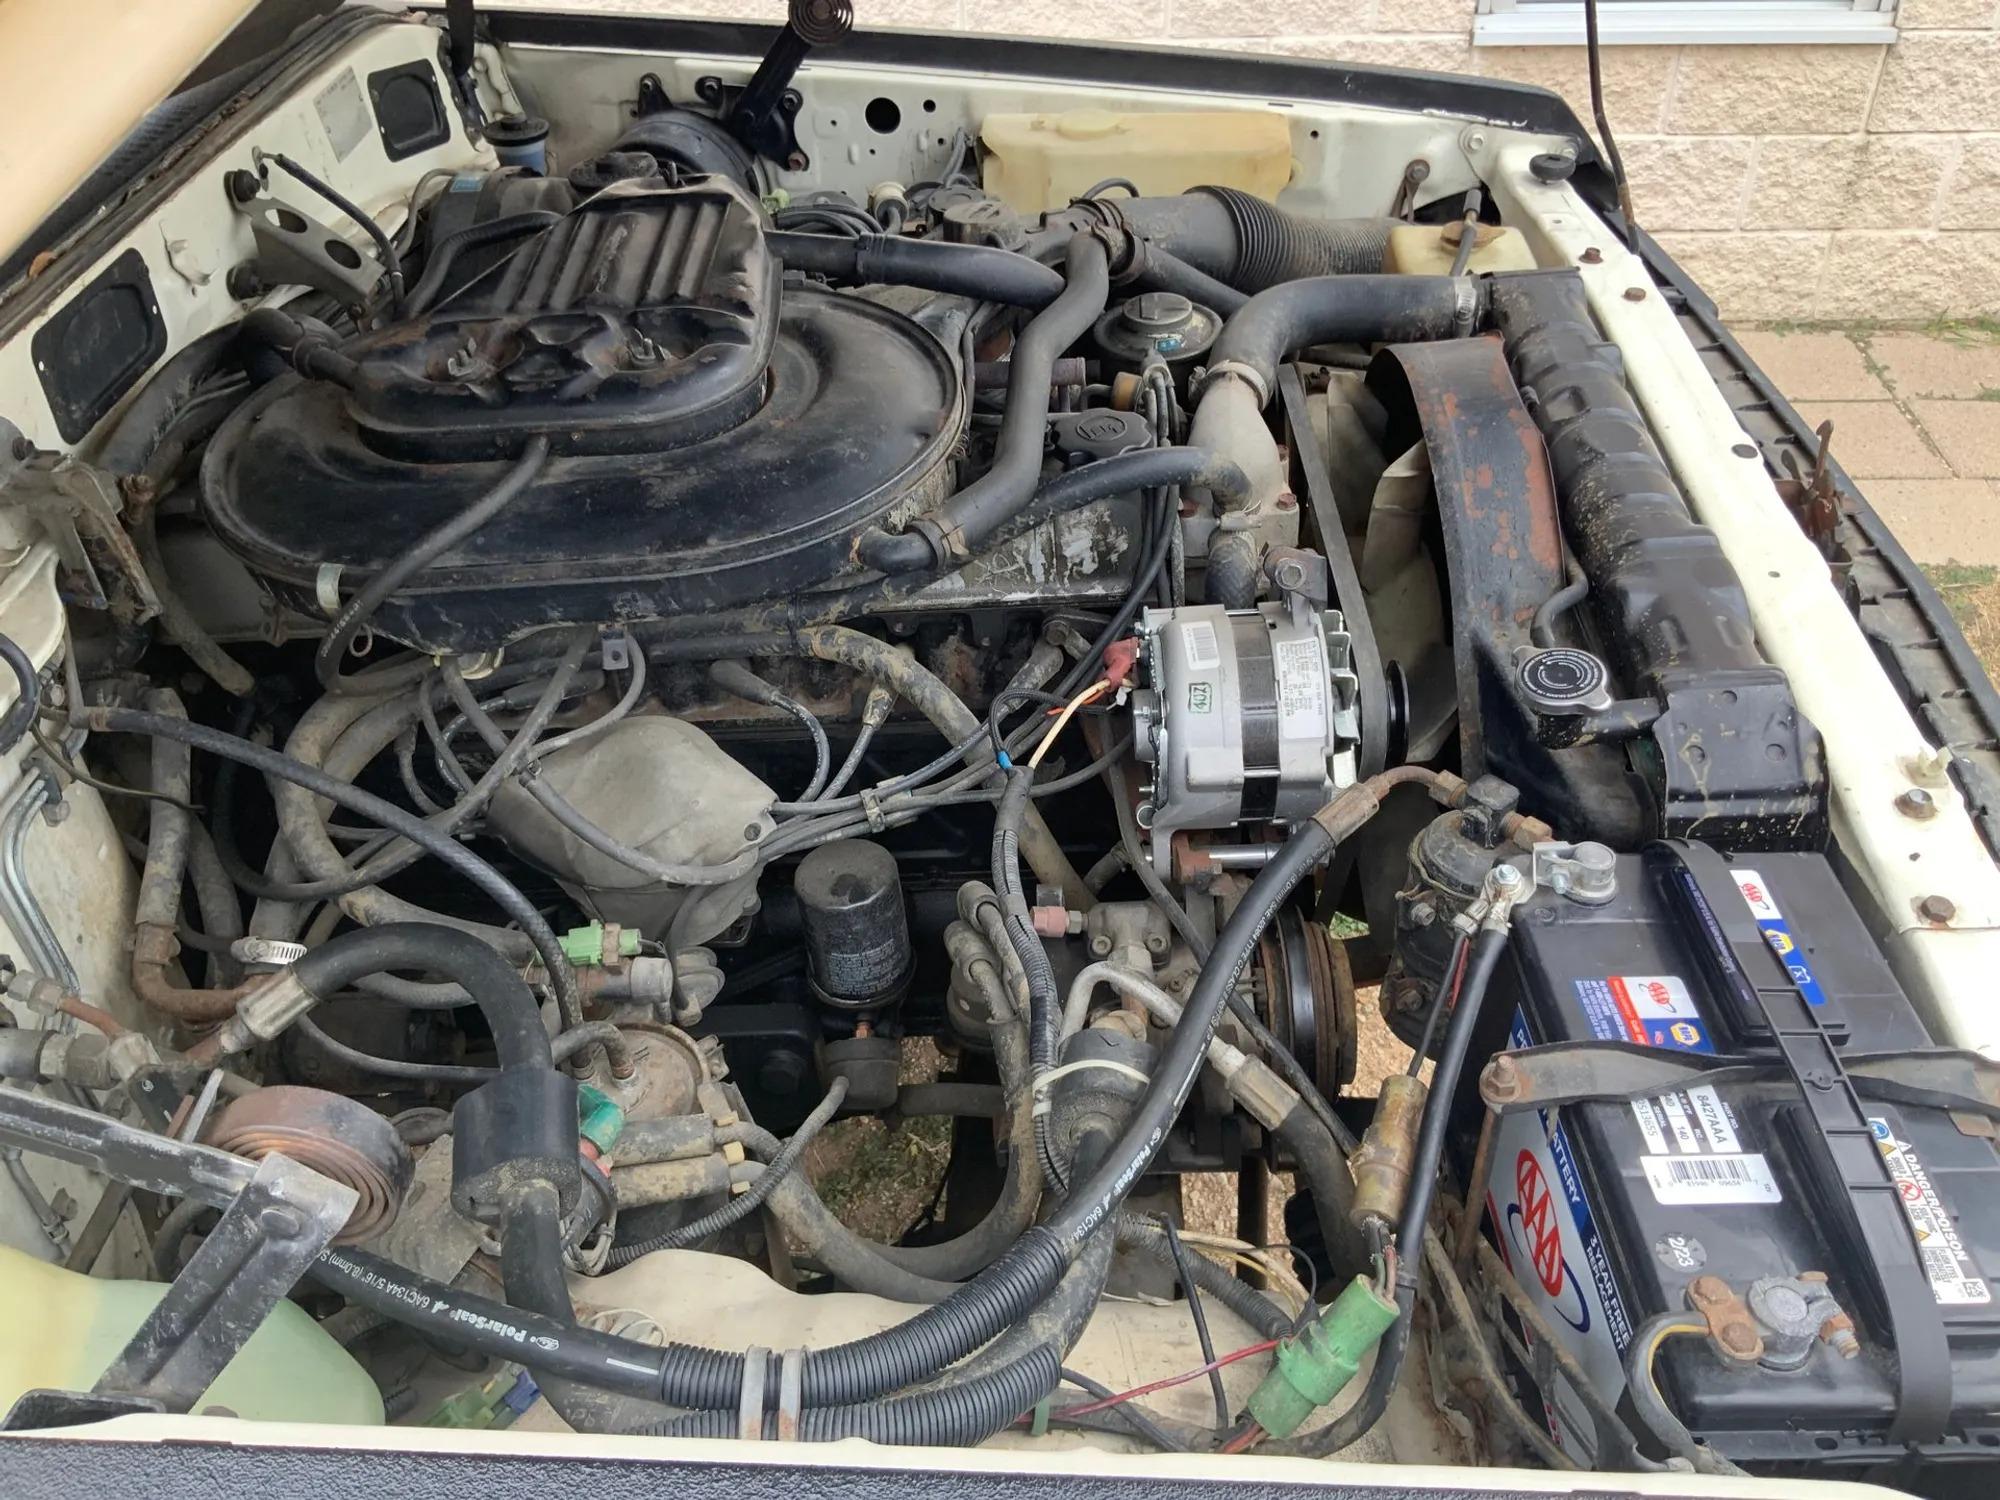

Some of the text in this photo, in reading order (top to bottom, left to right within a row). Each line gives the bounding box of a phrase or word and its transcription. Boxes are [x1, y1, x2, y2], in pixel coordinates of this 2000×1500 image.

[1677, 1126, 1690, 1140] 140
[1697, 1095, 1727, 1143] 8427AAA
[1550, 1131, 1580, 1203] ATTERY
[1517, 1149, 1563, 1297] AAA
[1905, 1153, 1968, 1261] DANGER/POISON
[328, 1252, 364, 1279] (8.0mm)
[1667, 1236, 1694, 1267] 2/23
[386, 1280, 431, 1309] 6AC134A
[1586, 1247, 1624, 1350] REPLACEMENT
[1590, 1236, 1631, 1347] 3 YEAR FREE
